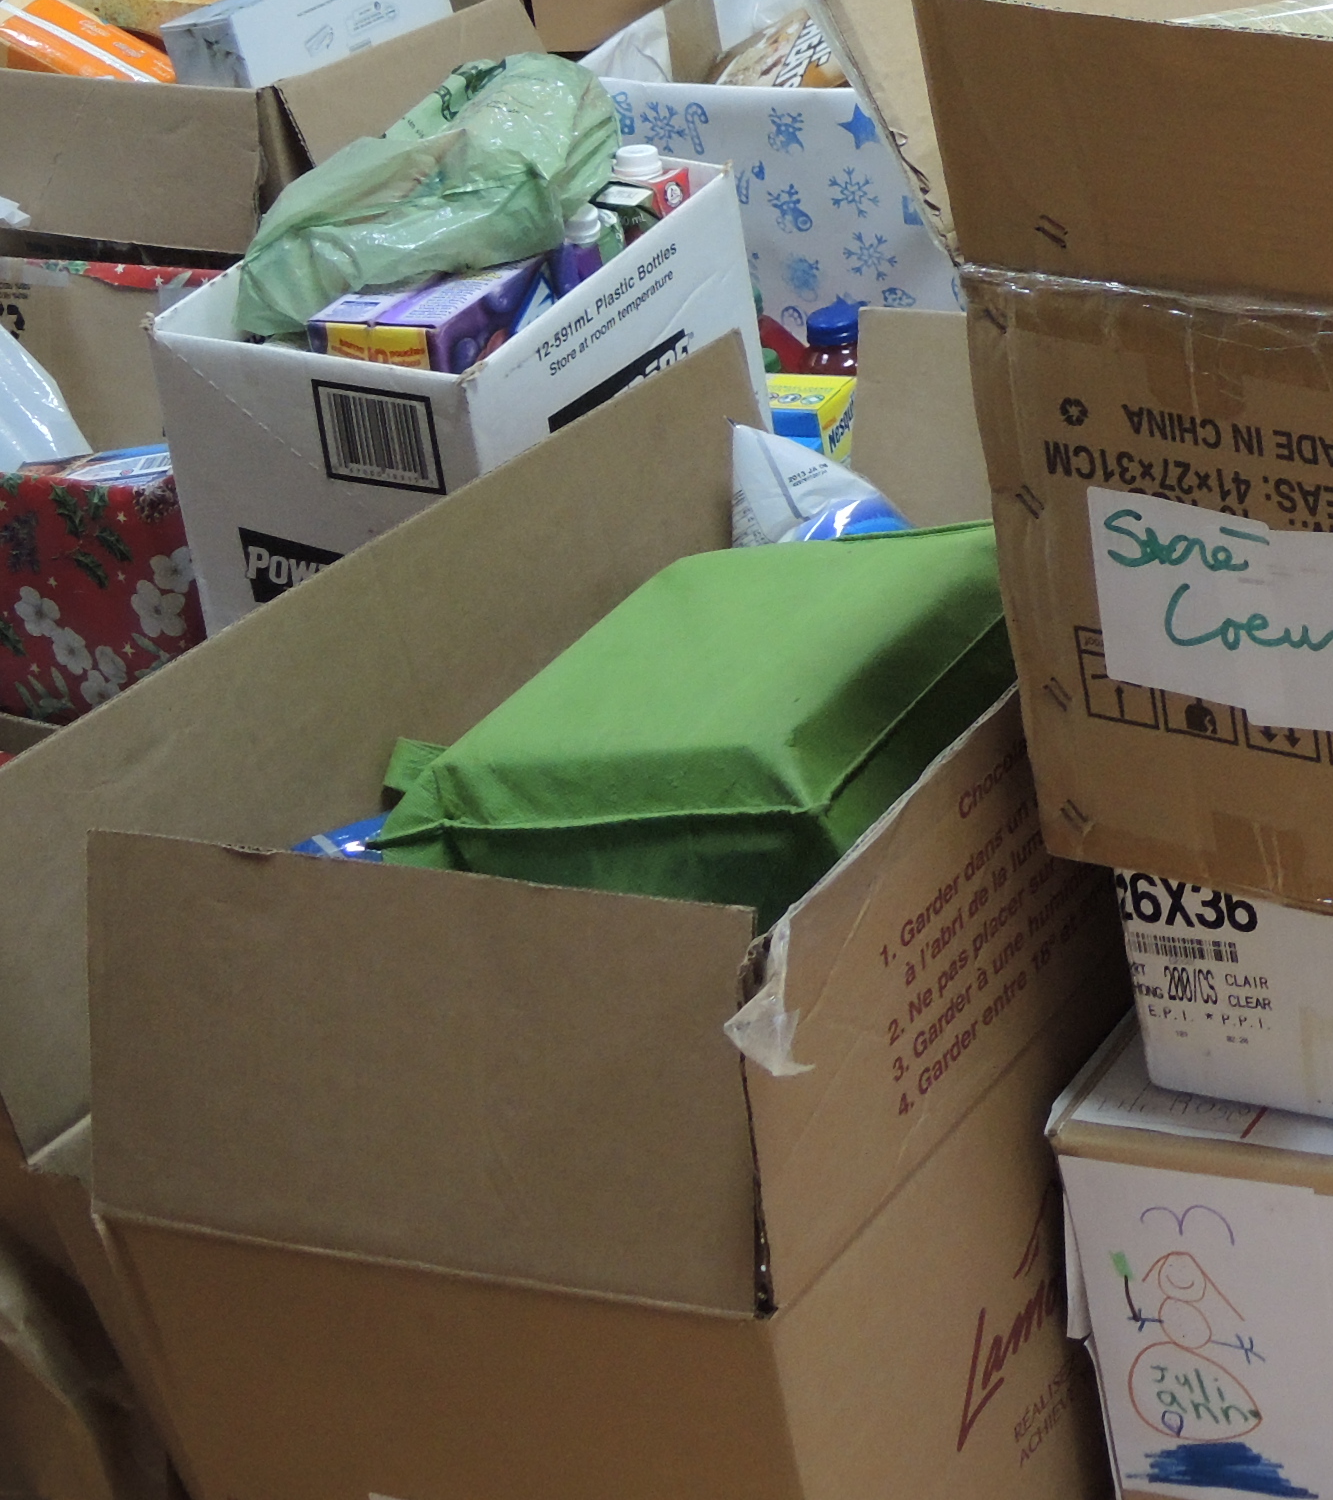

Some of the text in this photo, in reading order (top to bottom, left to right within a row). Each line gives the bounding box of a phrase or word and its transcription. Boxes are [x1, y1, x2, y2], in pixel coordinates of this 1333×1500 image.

[535, 308, 595, 363] 12-591mL
[594, 275, 636, 315] Plastic
[636, 241, 678, 281] Bottles
[549, 268, 674, 377] Store at room temperature
[1121, 403, 1223, 449] CHINA
[1231, 421, 1264, 457] IN
[880, 943, 897, 968] 1.
[900, 871, 961, 949] Garder
[963, 835, 1003, 883] dans
[887, 854, 1057, 1047] 2. Ne pas placer sur
[904, 958, 916, 988] à
[919, 907, 964, 973] l'abri
[967, 882, 990, 919] de
[992, 864, 1009, 894] la
[892, 927, 1025, 1084] 3. Garder à une
[1224, 973, 1269, 990] CLAIR
[1228, 994, 1273, 1011] CLEAR
[897, 1090, 915, 1118] 4.
[917, 1020, 978, 1097] Garder
[981, 972, 1028, 1029] entre
